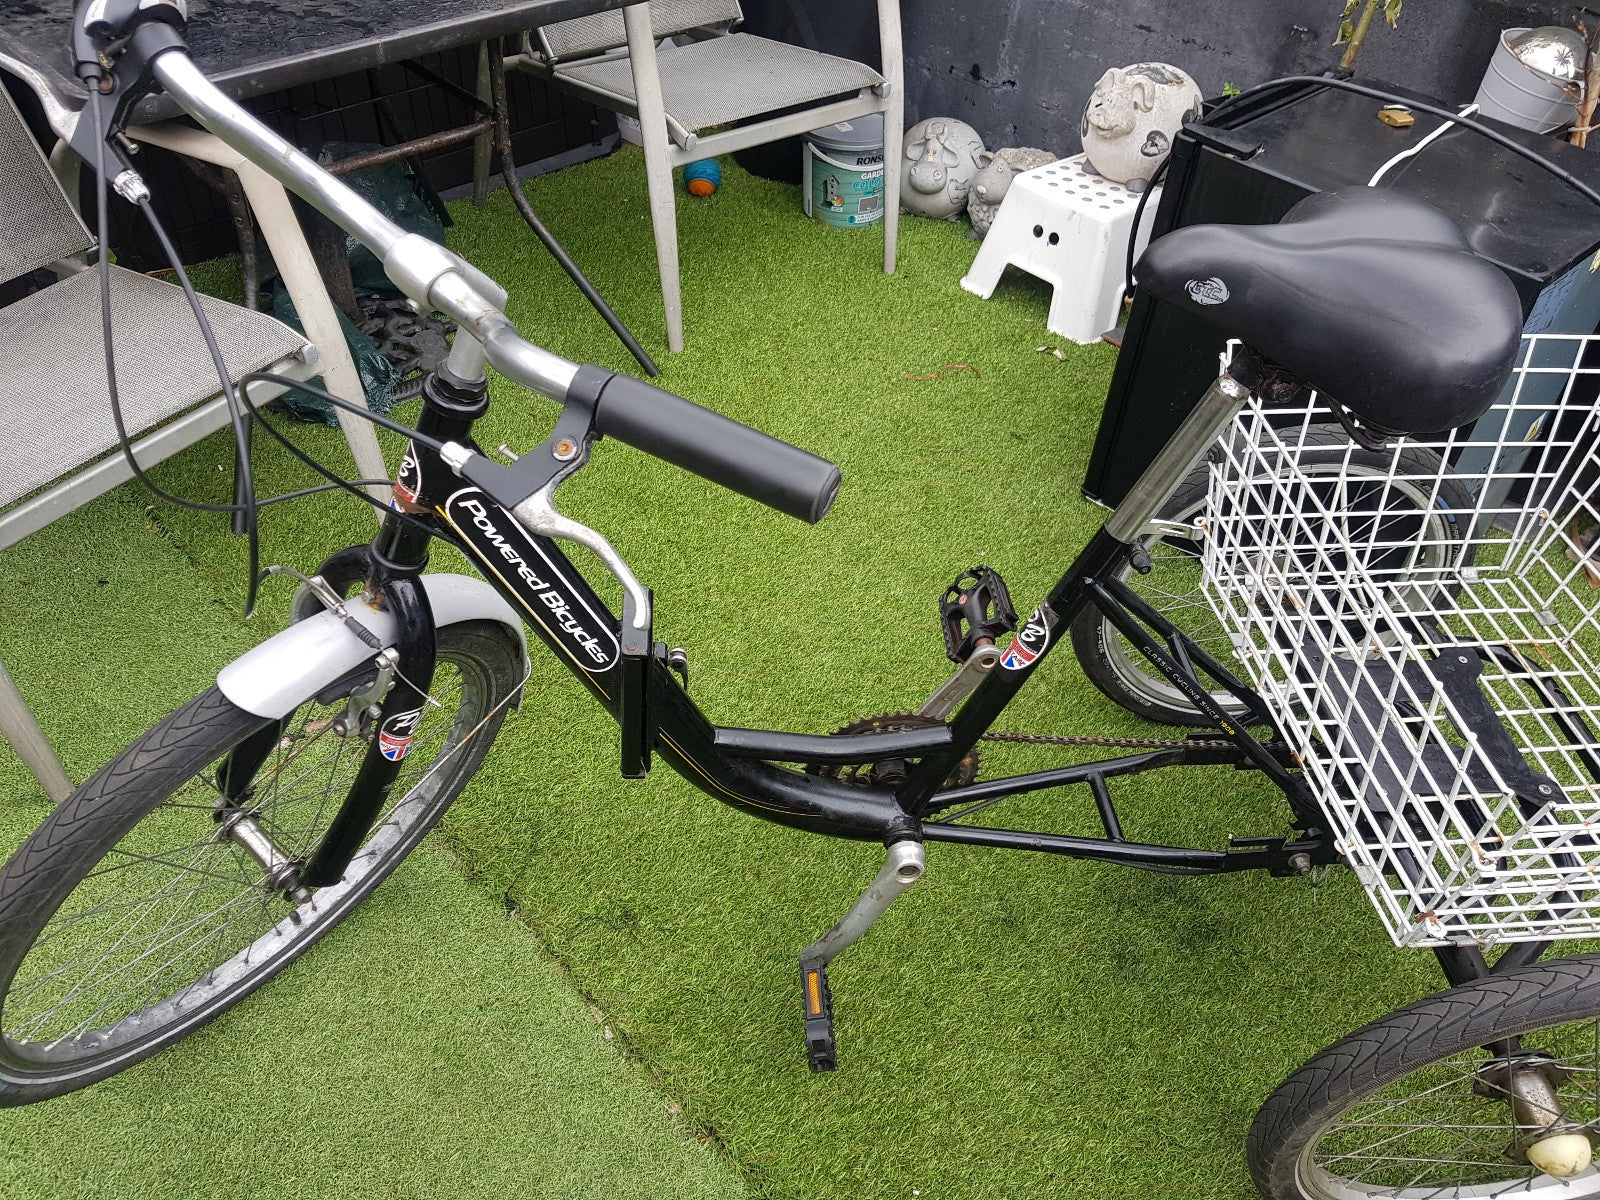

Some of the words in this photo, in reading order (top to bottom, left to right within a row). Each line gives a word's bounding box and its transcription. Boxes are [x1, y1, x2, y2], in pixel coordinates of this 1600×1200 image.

[1142, 645, 1173, 673] CLASSIC
[1172, 673, 1200, 701] CYCLING
[1199, 701, 1220, 720] SINCE
